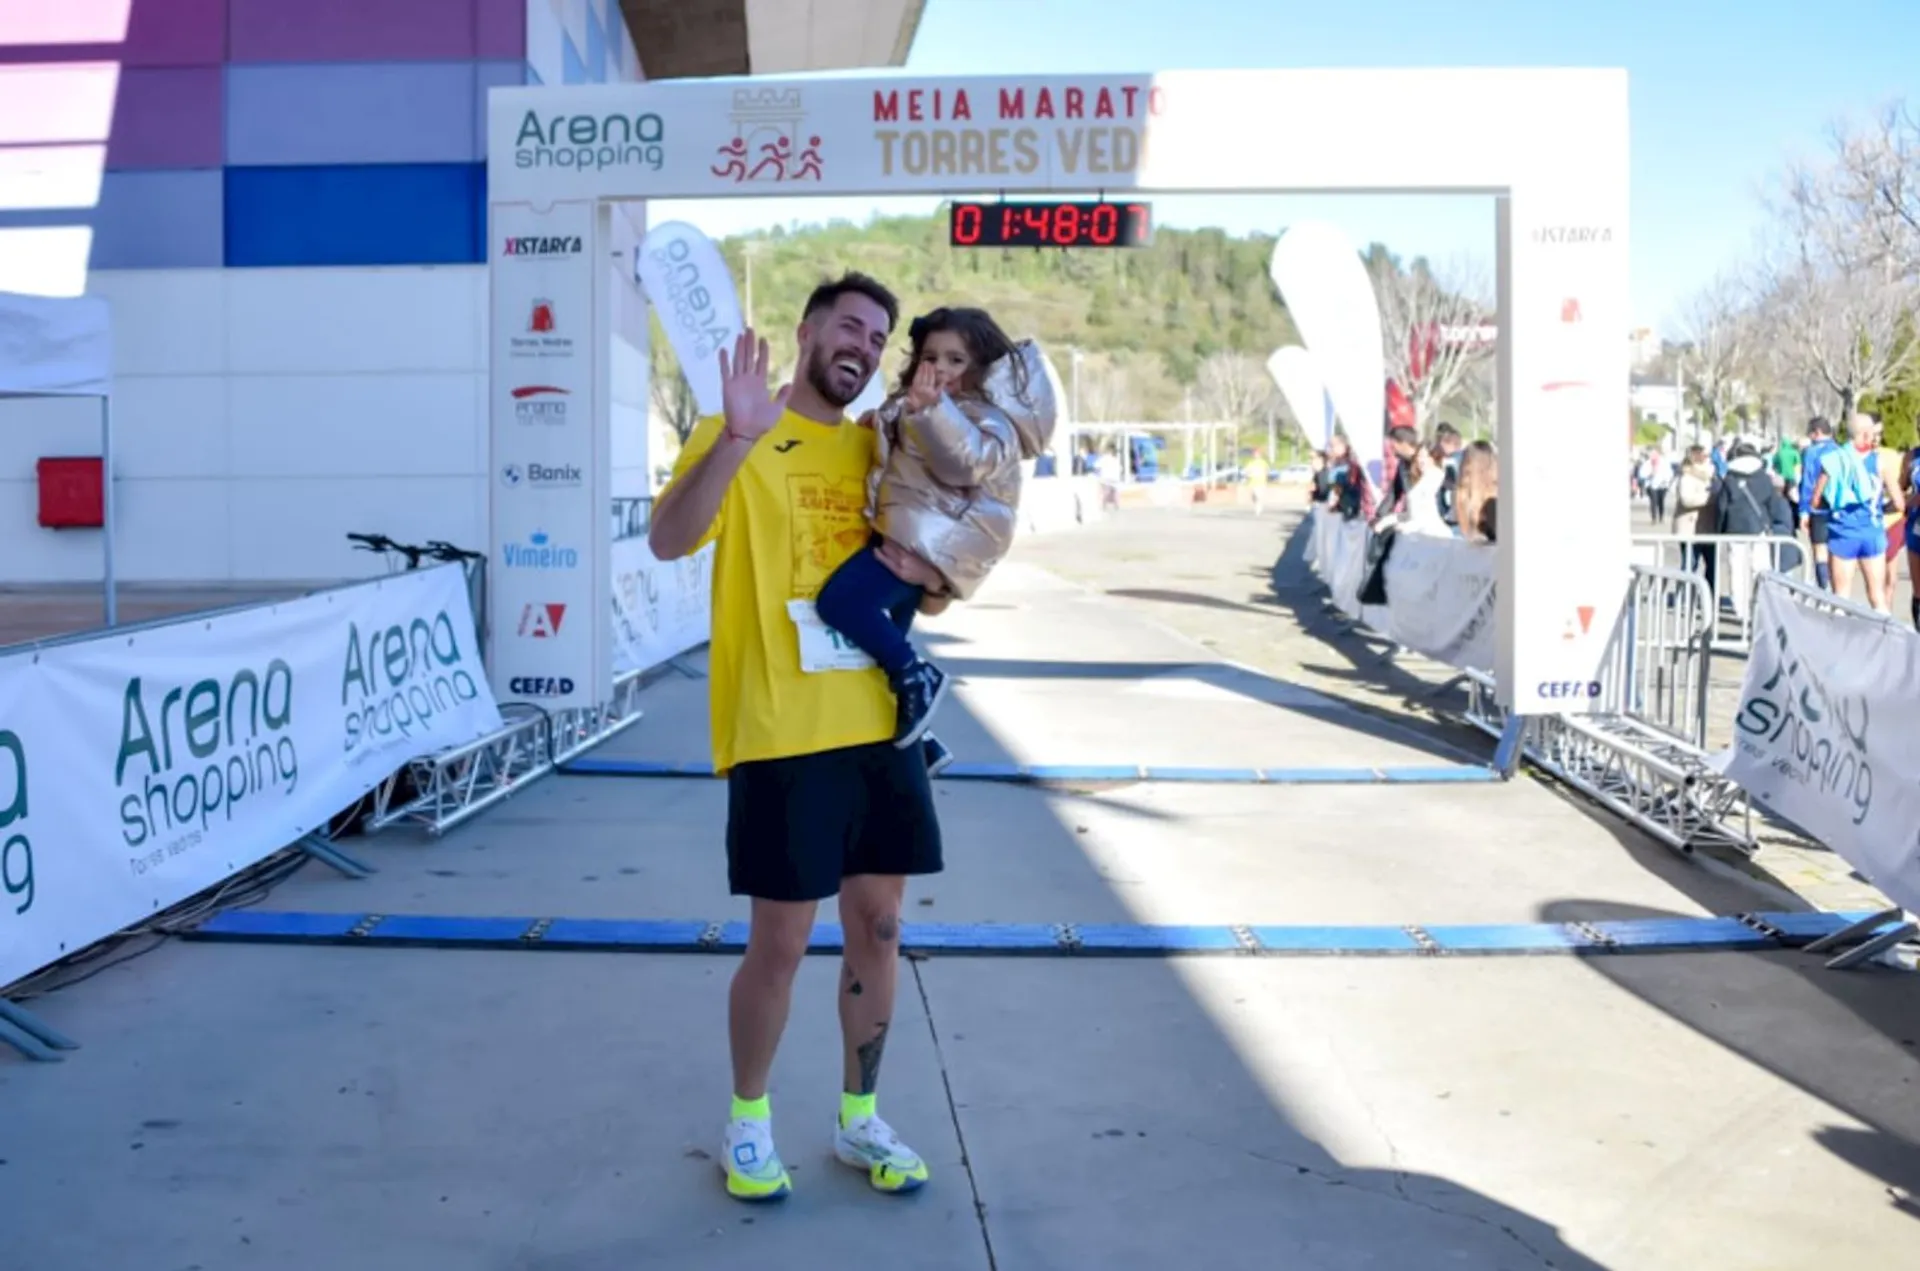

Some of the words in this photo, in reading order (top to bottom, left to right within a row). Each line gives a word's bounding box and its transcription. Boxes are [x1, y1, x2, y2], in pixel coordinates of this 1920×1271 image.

[873, 89, 972, 122] MEIA
[515, 109, 664, 146] Arena
[515, 142, 664, 171] shopping
[874, 127, 1040, 176] TORRES
[954, 204, 1147, 244] 01:48:07
[527, 463, 582, 481] Banix
[503, 544, 578, 568] Vimeiro
[341, 610, 462, 706] Arena
[509, 677, 575, 695] CEFAD
[115, 658, 293, 787] Arena
[119, 735, 299, 847] shopping
